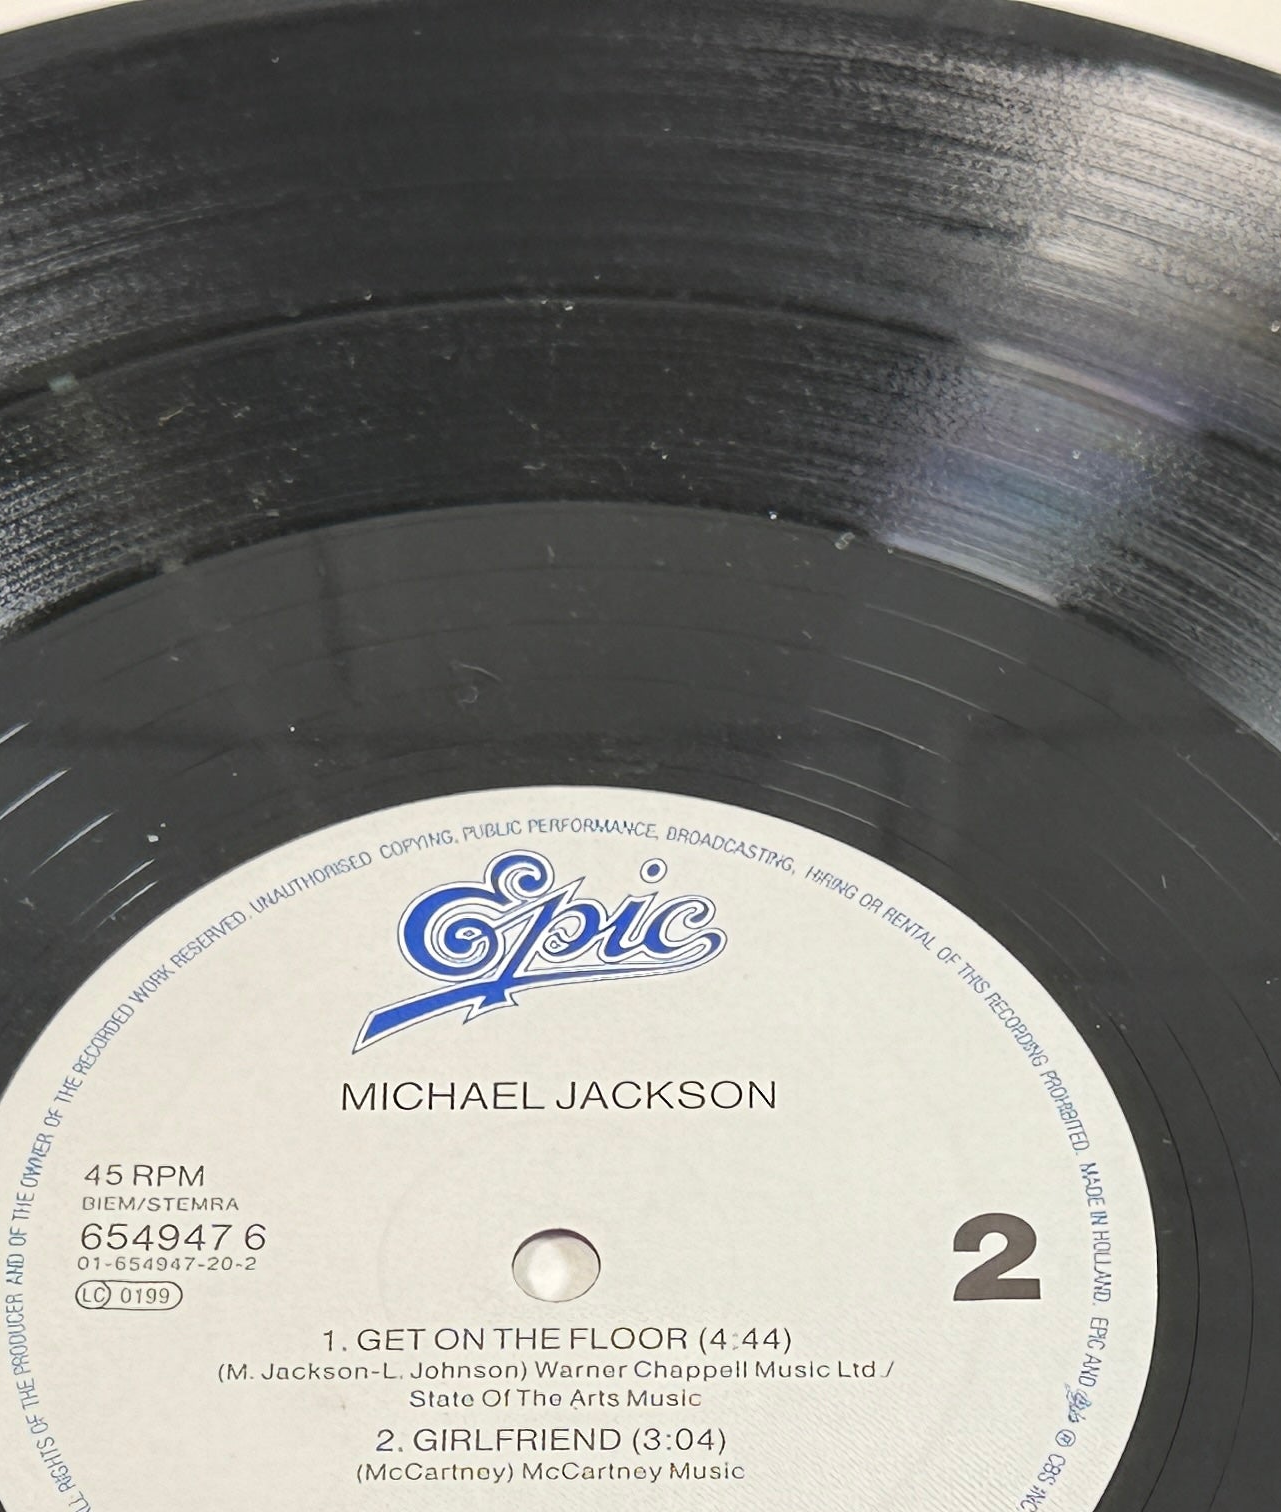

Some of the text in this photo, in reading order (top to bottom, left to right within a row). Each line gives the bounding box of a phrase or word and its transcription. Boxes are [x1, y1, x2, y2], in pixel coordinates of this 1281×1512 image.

[462, 820, 522, 842] PUBLIC
[249, 851, 372, 914] UNAUTHORISED
[805, 866, 858, 900] HIRING
[859, 893, 884, 914] OR
[882, 907, 937, 951] RENTAL
[352, 849, 728, 1055] Epic
[936, 946, 962, 964] OF
[128, 964, 175, 1004] WORK
[958, 962, 991, 994] THIS
[72, 1003, 135, 1076] RECORDED
[984, 992, 1049, 1067] RECORDING
[54, 1076, 83, 1104] THE
[341, 1080, 776, 1111] MICHAEL JACKSON
[43, 1108, 63, 1127] OF
[20, 1133, 54, 1188] OWNER
[84, 1164, 205, 1187] 45 RPM
[1079, 1162, 1106, 1207] MADE
[12, 1192, 35, 1221] THE
[82, 1196, 239, 1212] BIEM/STEMRA
[1090, 1210, 1109, 1226] IN
[9, 1226, 27, 1246] OF
[81, 1223, 266, 1251] 654947 6
[6, 1253, 24, 1285] AND
[77, 1256, 257, 1271] 01-654947-20-2
[953, 1212, 1041, 1301] 2
[82, 1286, 170, 1304] LC 0199
[6, 1293, 31, 1376] PRODUCER
[323, 1327, 792, 1355] 1. GET ON THE FLOOR (4:44)
[1087, 1317, 1109, 1351] EPIC
[218, 1362, 254, 1383] (M.
[261, 1362, 403, 1381] Jackson-L.
[410, 1361, 528, 1382] Johnson)
[535, 1361, 628, 1379] Warner
[634, 1360, 748, 1382] Chappell
[756, 1360, 830, 1379] Music
[1078, 1353, 1102, 1387] AND
[16, 1378, 39, 1410] THE
[409, 1389, 702, 1408] State Of The Arts Music
[25, 1414, 49, 1434] OF
[376, 1428, 727, 1455] 2. GIRLFRIEND (3:04)
[36, 1436, 76, 1493] RIGHTS
[356, 1462, 746, 1484] (McCartney) McCartney Music
[1037, 1453, 1066, 1486] CBS
